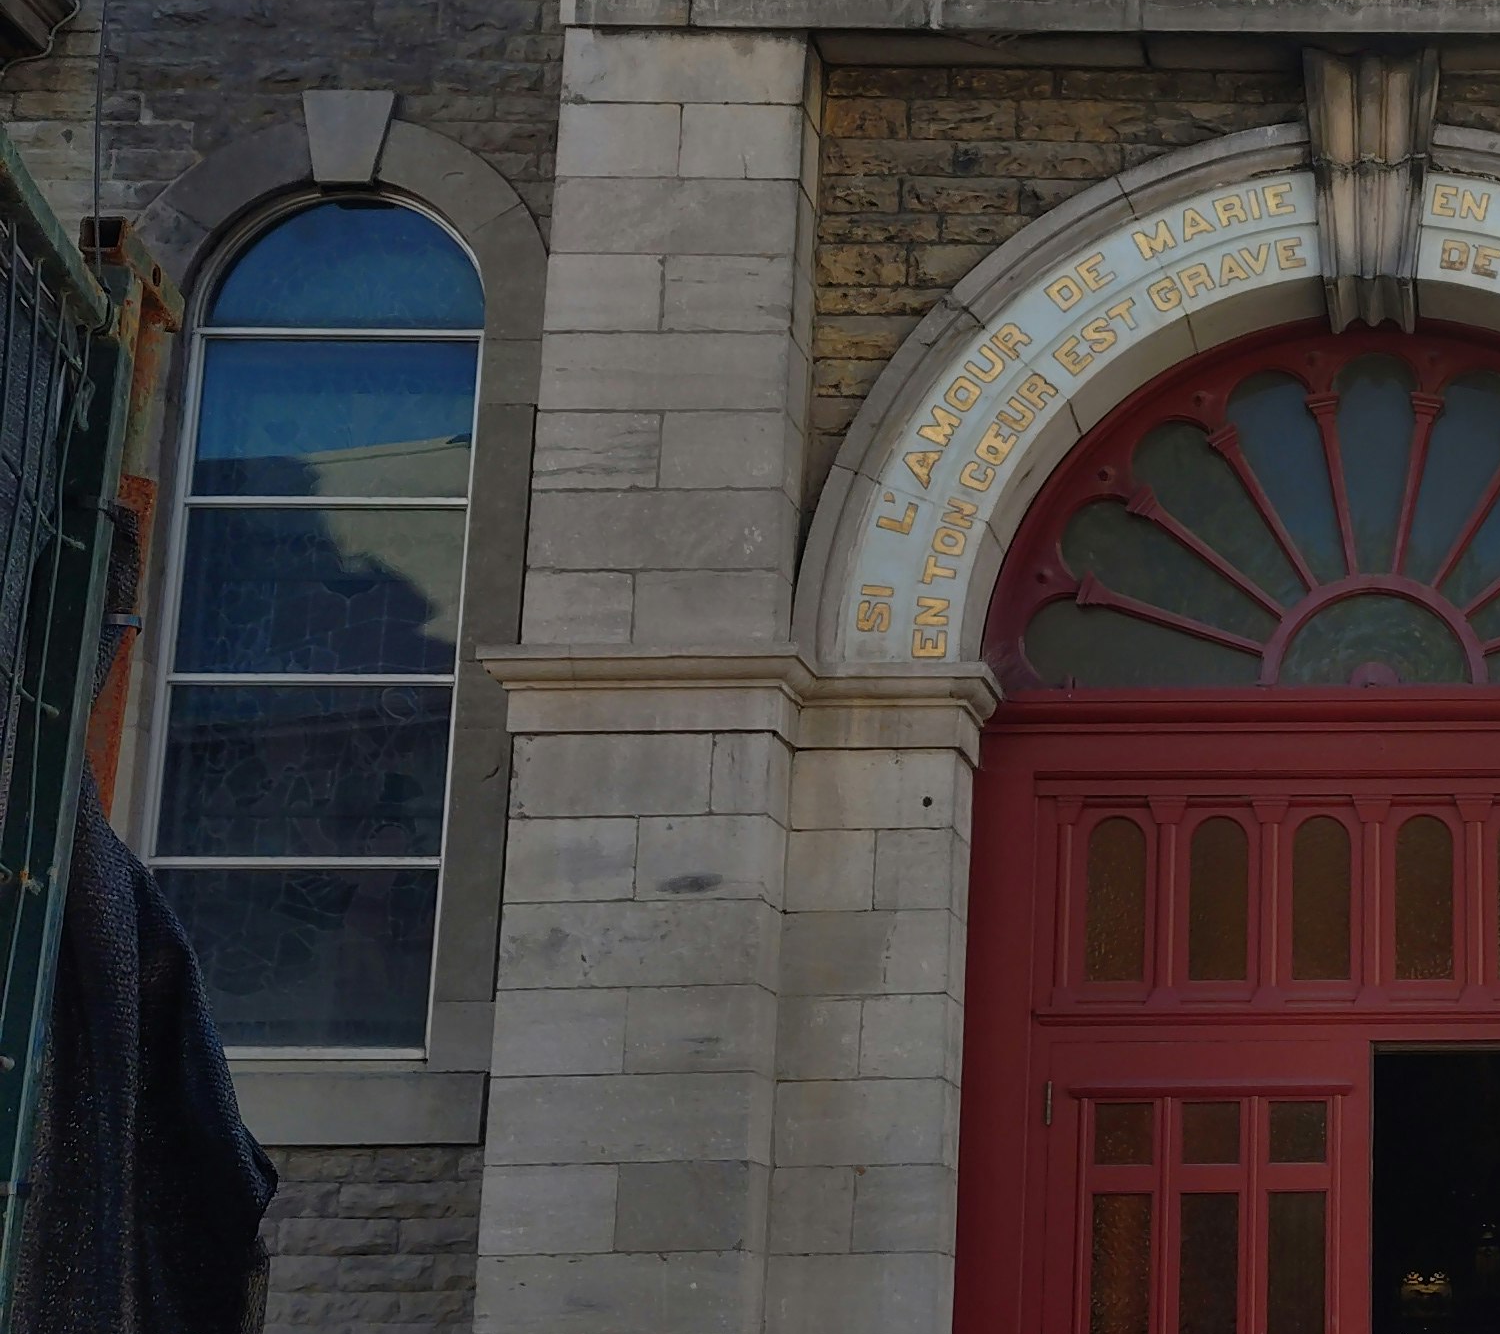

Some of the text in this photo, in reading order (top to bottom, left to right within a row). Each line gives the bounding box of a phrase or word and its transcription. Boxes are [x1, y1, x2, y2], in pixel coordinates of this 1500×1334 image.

[1430, 183, 1490, 222] EN
[1145, 236, 1307, 312] GRAVE
[1052, 296, 1138, 378] EST
[855, 181, 1296, 633] SI L'AMOUR DE MARIE
[921, 496, 979, 585] TON
[911, 595, 950, 659] EN
